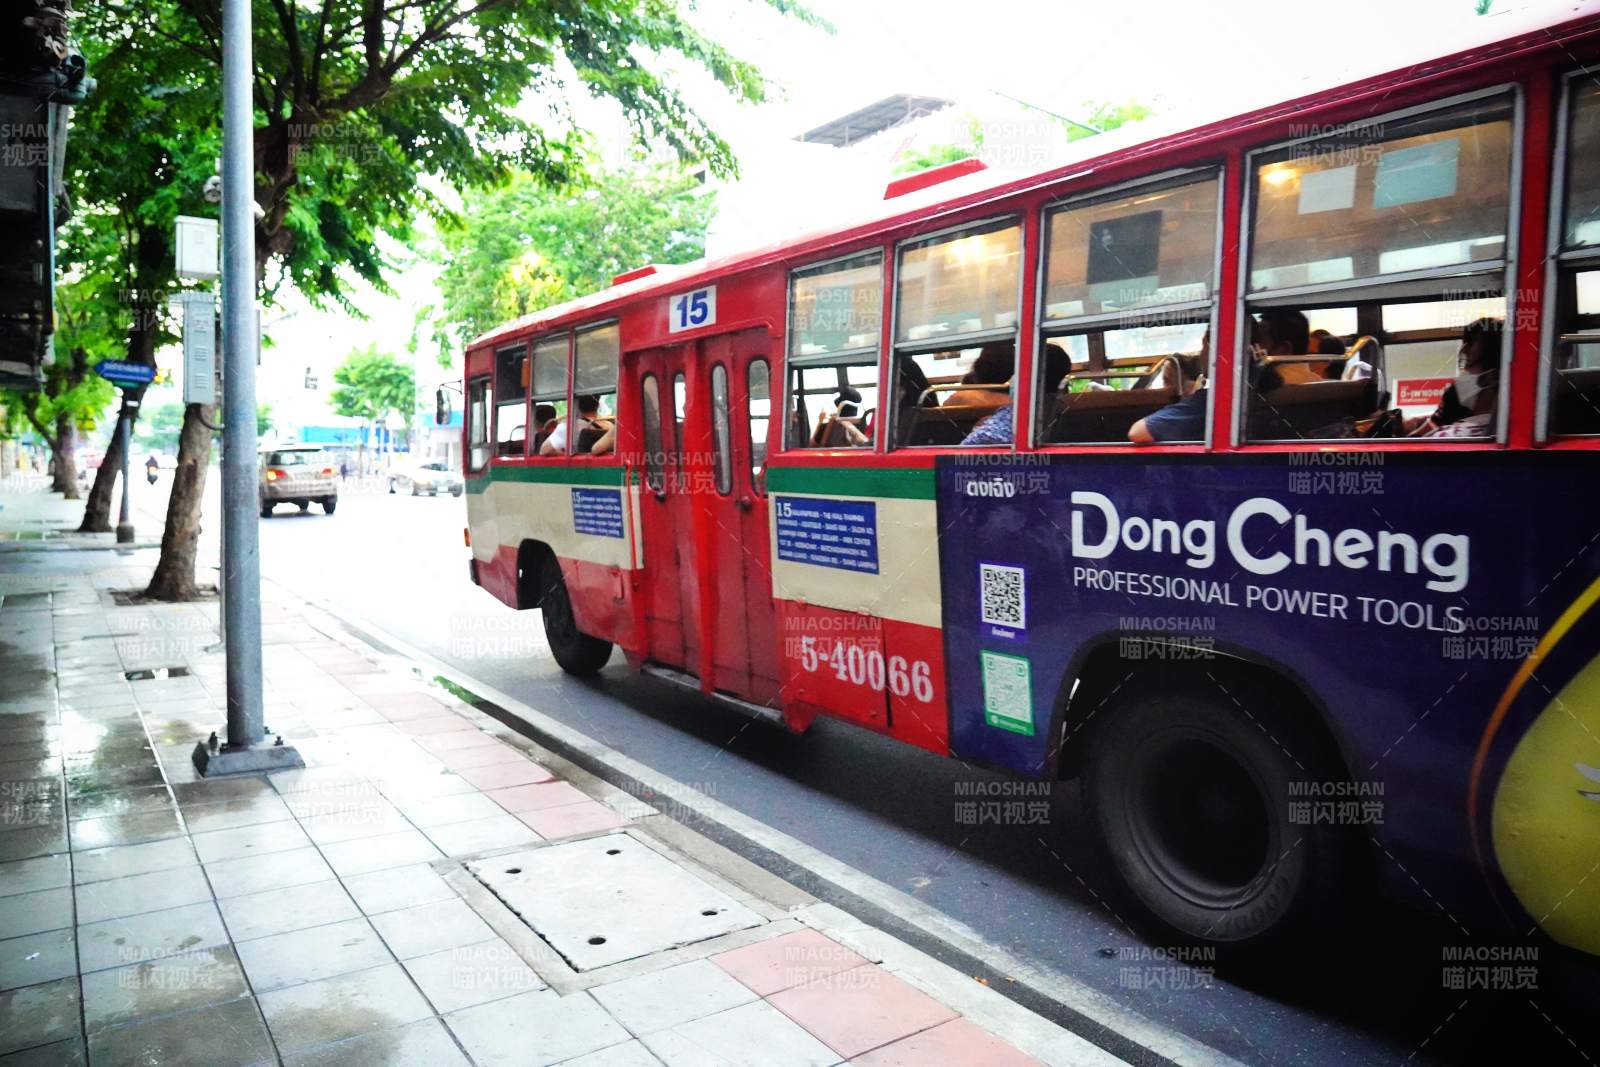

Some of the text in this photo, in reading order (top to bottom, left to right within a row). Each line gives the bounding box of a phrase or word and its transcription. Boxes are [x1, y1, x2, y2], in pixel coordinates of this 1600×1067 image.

[677, 290, 708, 327] 15
[776, 502, 792, 517] 15
[1073, 566, 1467, 634] PROFESSIONAL POWER TOOLS
[801, 635, 934, 703] 5-40066
